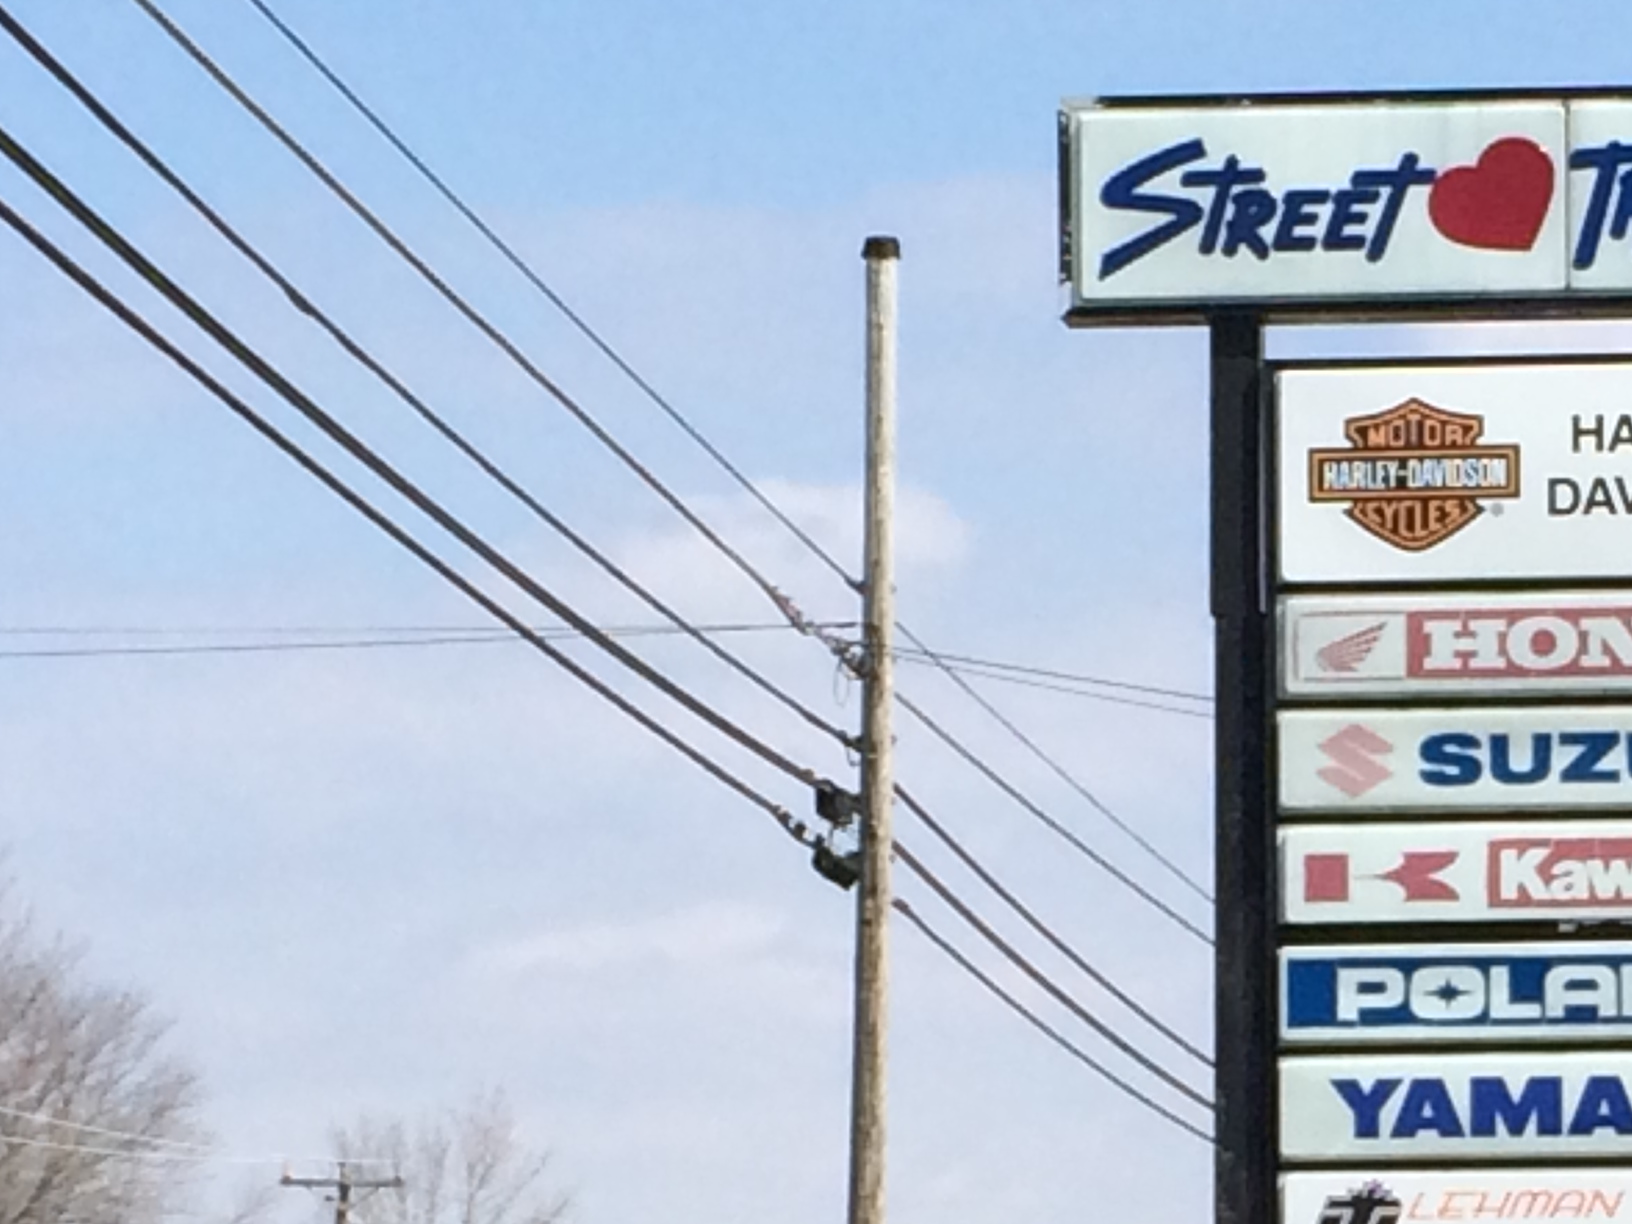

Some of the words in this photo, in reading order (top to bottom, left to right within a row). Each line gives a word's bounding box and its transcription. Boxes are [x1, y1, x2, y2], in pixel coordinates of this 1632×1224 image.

[1366, 413, 1465, 447] MOTOR
[1322, 457, 1508, 491] HARLEY-DAVIDSON
[1366, 500, 1461, 538] CYCLES
[1406, 1188, 1626, 1221] LEHMAN
